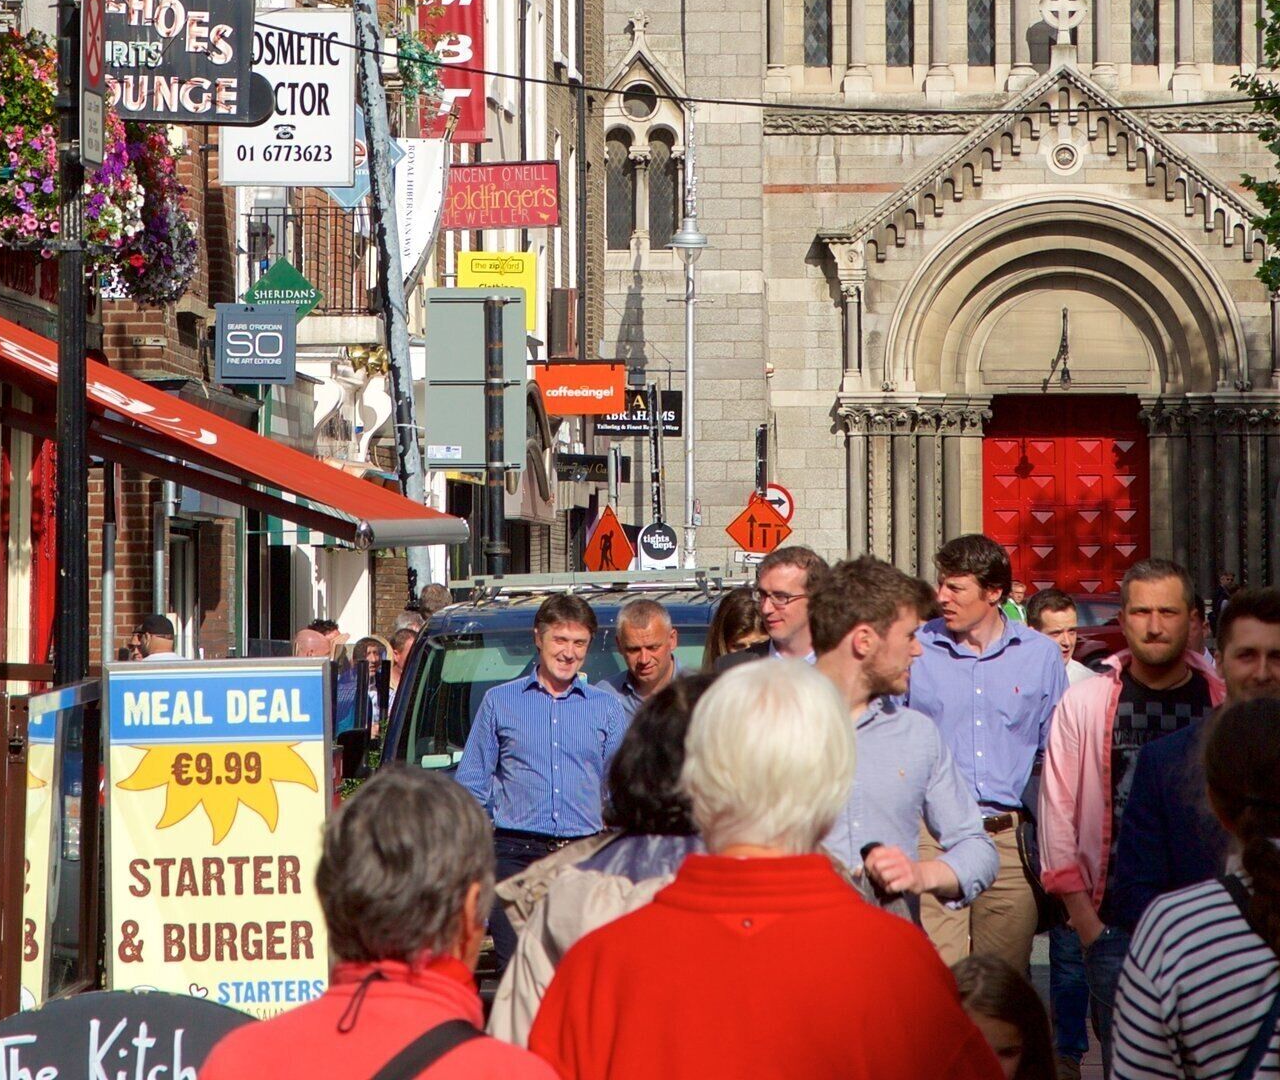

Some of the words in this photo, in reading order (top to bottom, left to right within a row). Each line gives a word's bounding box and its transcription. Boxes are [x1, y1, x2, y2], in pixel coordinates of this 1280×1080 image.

[105, 40, 164, 68] IRITS
[252, 31, 340, 67] OSMETIC
[274, 81, 331, 117] CTOR
[237, 144, 255, 162] 01
[263, 144, 333, 162] 6773623
[405, 144, 416, 177] ROYAL
[450, 168, 494, 183] INCENT
[501, 166, 550, 182] O'NEILL
[254, 288, 316, 300] SHERIDANS
[226, 331, 283, 357] SO
[226, 357, 240, 365] FINE
[240, 357, 253, 365] ART
[254, 357, 282, 365] EDITIONS
[545, 385, 614, 400] coffeeangel
[632, 394, 646, 410] A
[643, 533, 670, 545] tights
[652, 540, 676, 551] dept.
[122, 689, 214, 727] MEAL
[226, 688, 311, 723] DEAL
[170, 751, 262, 787] €9.99
[128, 855, 303, 898] STARTER
[117, 920, 145, 963] &
[162, 920, 315, 963] BURGER
[217, 980, 325, 1004] STARTERS
